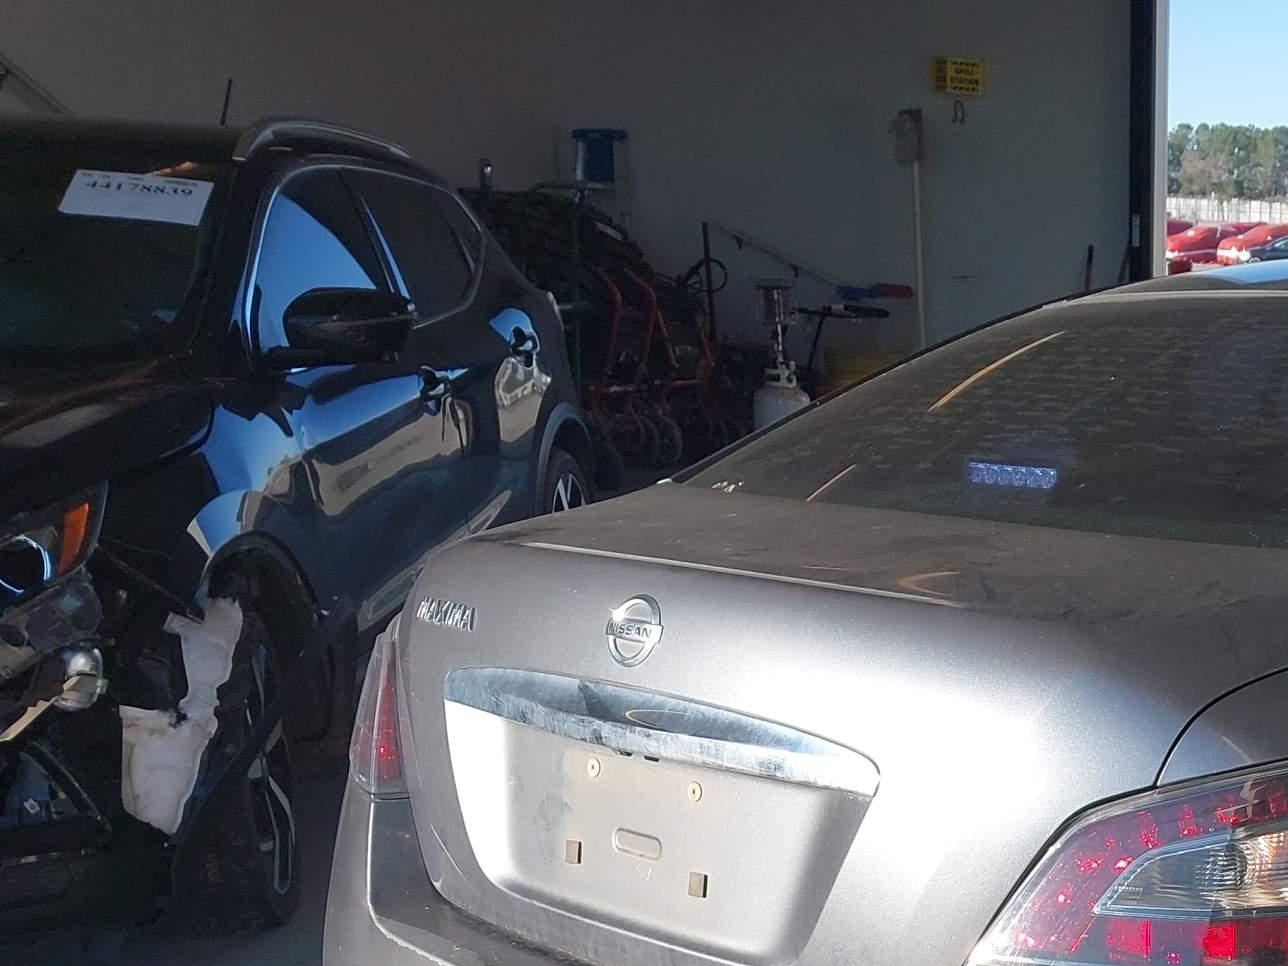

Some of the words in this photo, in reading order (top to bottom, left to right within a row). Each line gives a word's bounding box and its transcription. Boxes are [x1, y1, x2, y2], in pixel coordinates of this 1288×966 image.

[85, 180, 193, 196] 44178839
[416, 595, 478, 632] MAXIMA
[607, 622, 653, 638] NISSAN
